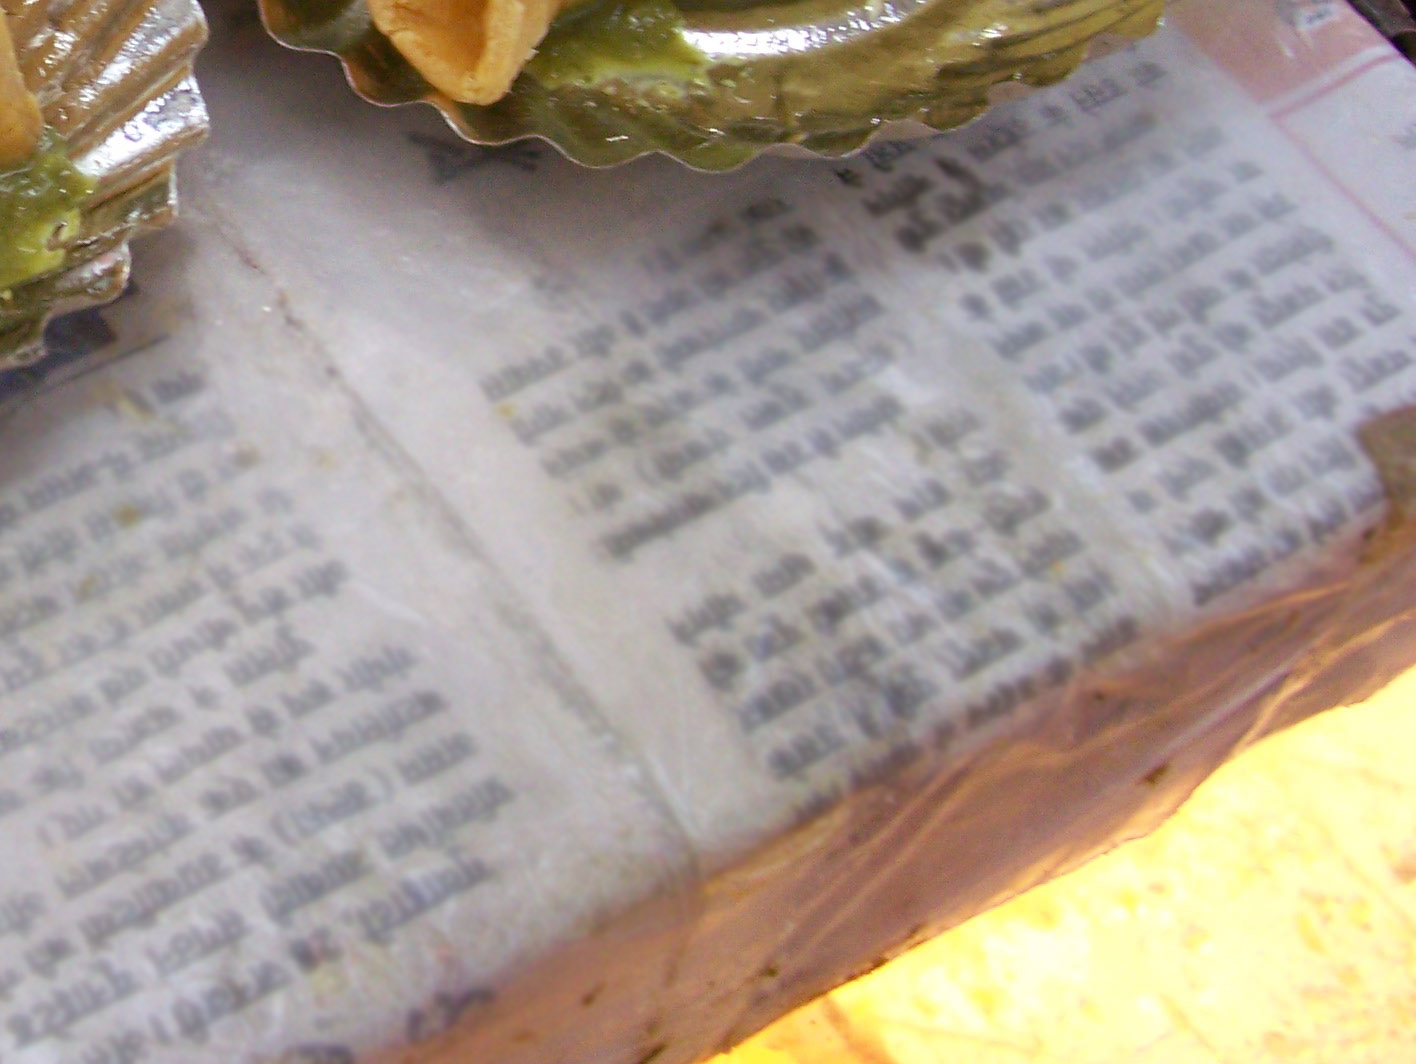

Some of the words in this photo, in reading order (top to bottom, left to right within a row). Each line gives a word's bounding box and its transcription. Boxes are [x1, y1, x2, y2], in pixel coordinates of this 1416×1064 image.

[84, 698, 185, 767] बताया
[148, 718, 247, 787] घायल
[27, 753, 86, 806] कि
[109, 772, 159, 820] हो
